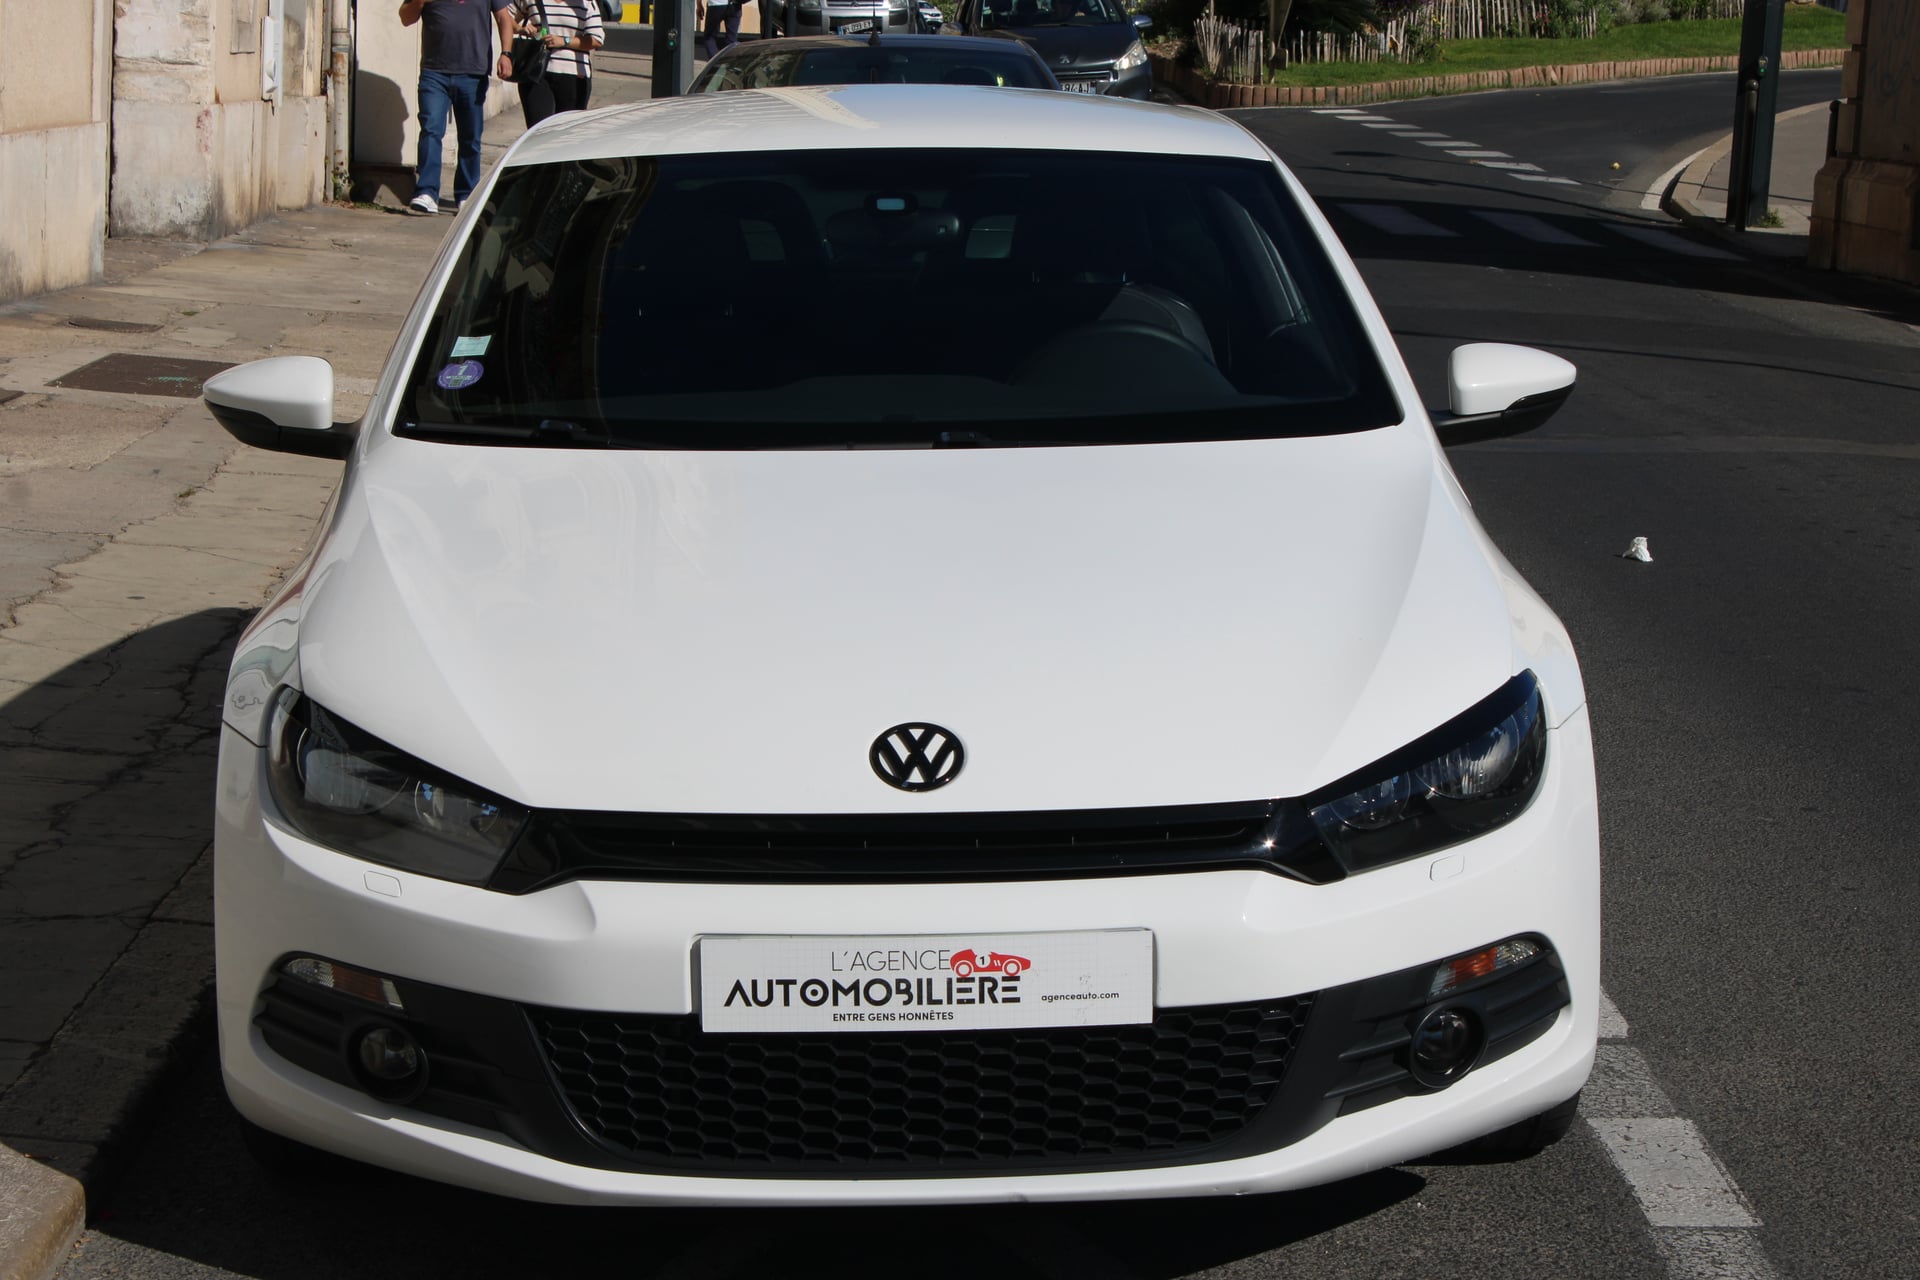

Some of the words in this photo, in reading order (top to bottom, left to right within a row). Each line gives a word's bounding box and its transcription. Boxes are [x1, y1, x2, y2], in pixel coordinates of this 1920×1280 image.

[1041, 991, 1120, 1003] agenceauto.com
[832, 1012, 865, 1022] ENTRE
[867, 1011, 896, 1021] GENS
[898, 1009, 954, 1021] HONNÊTES
